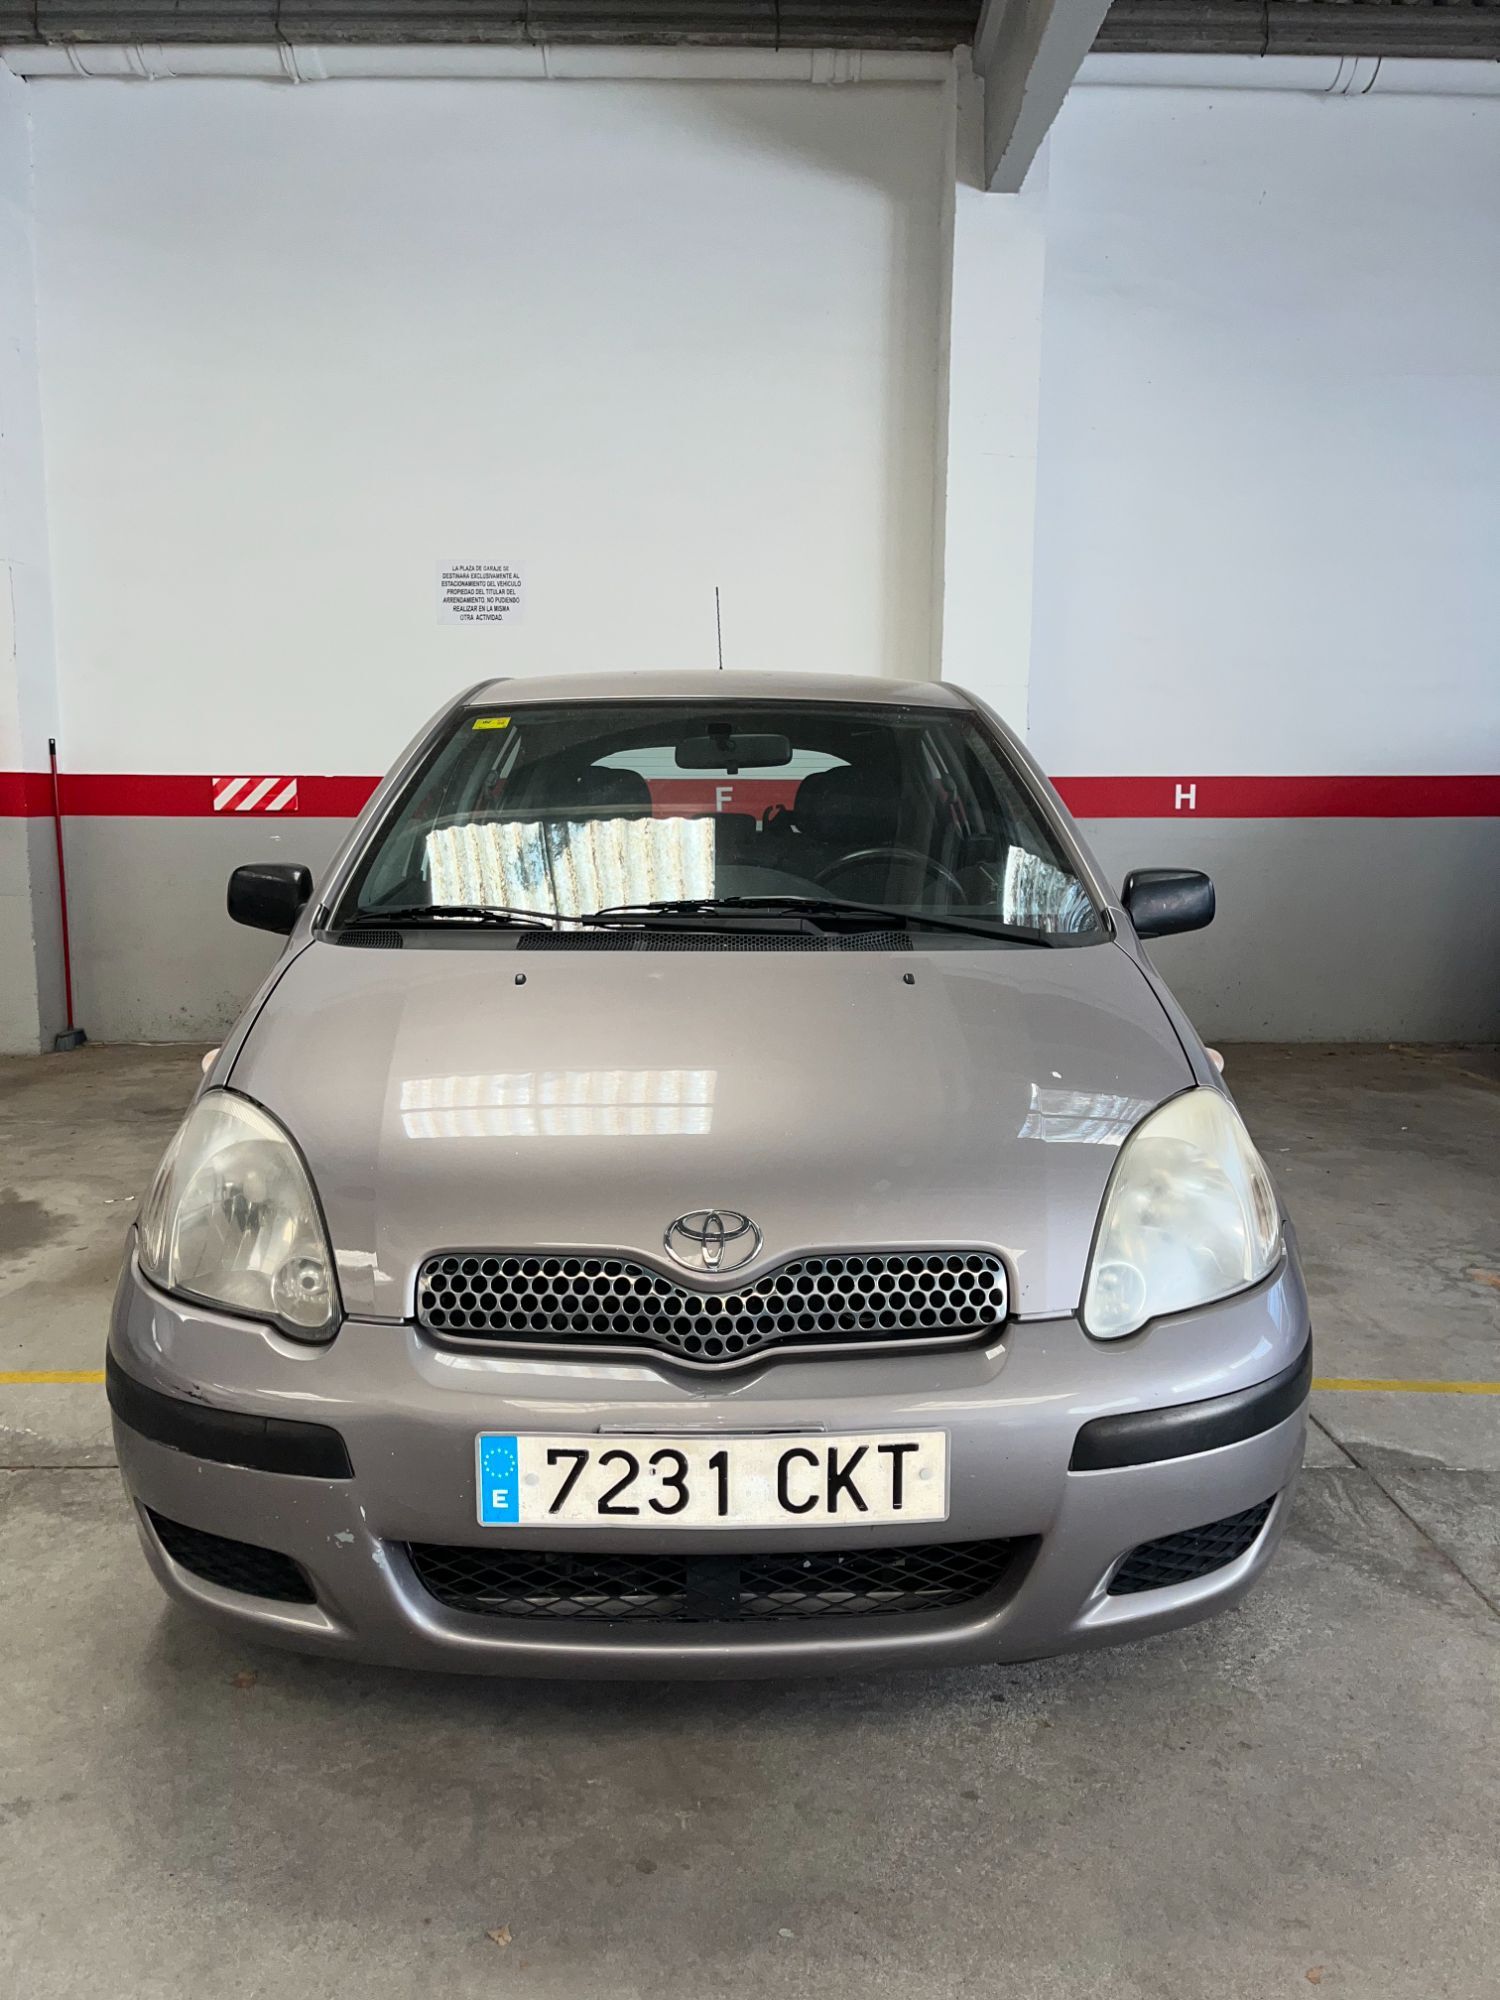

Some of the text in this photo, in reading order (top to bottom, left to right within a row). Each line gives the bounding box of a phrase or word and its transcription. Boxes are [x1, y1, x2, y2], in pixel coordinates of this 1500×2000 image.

[460, 613, 474, 621] OTRA
[716, 786, 733, 812] F
[1175, 784, 1196, 809] H
[547, 1442, 919, 1516] 7231 CKT
[492, 1489, 508, 1508] E
